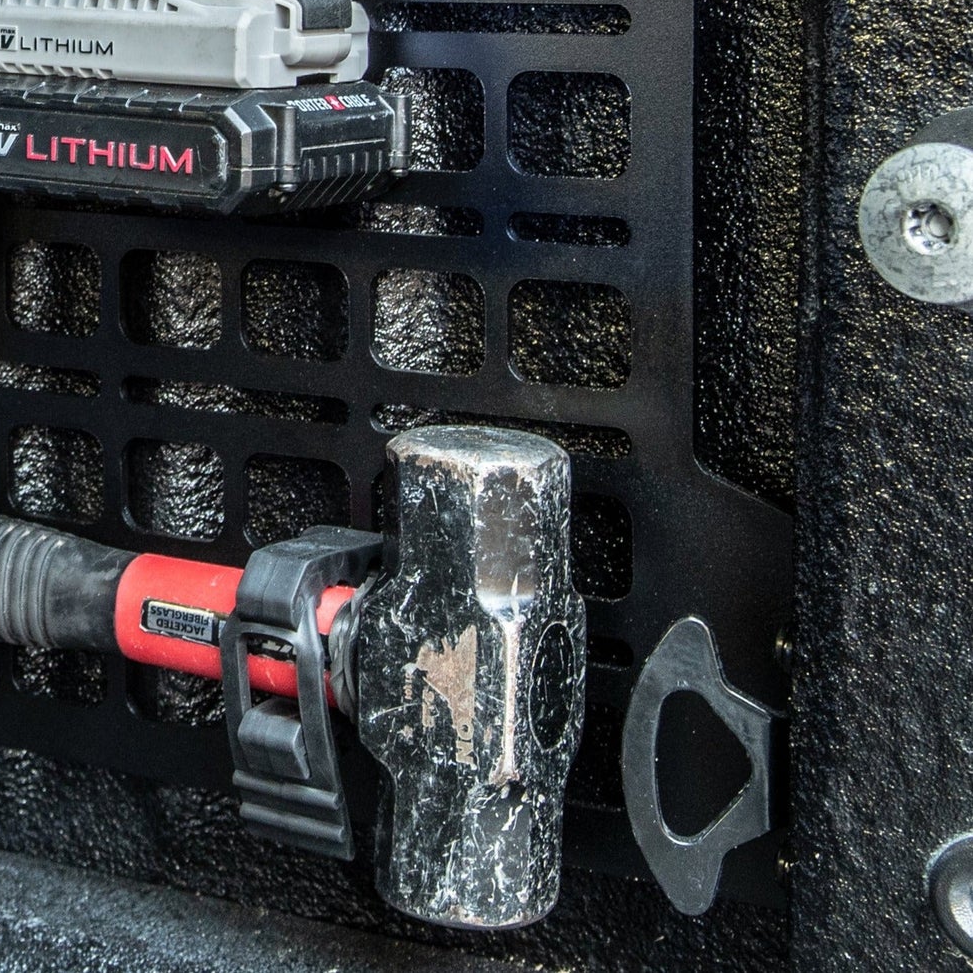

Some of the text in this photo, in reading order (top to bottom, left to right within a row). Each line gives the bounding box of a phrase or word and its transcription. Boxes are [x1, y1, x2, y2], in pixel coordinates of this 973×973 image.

[20, 36, 114, 56] LITHIUM
[338, 93, 371, 108] CABLE
[26, 134, 194, 175] LITHIUM
[150, 605, 210, 626] FIBERGLASS
[156, 618, 205, 637] JACKETED
